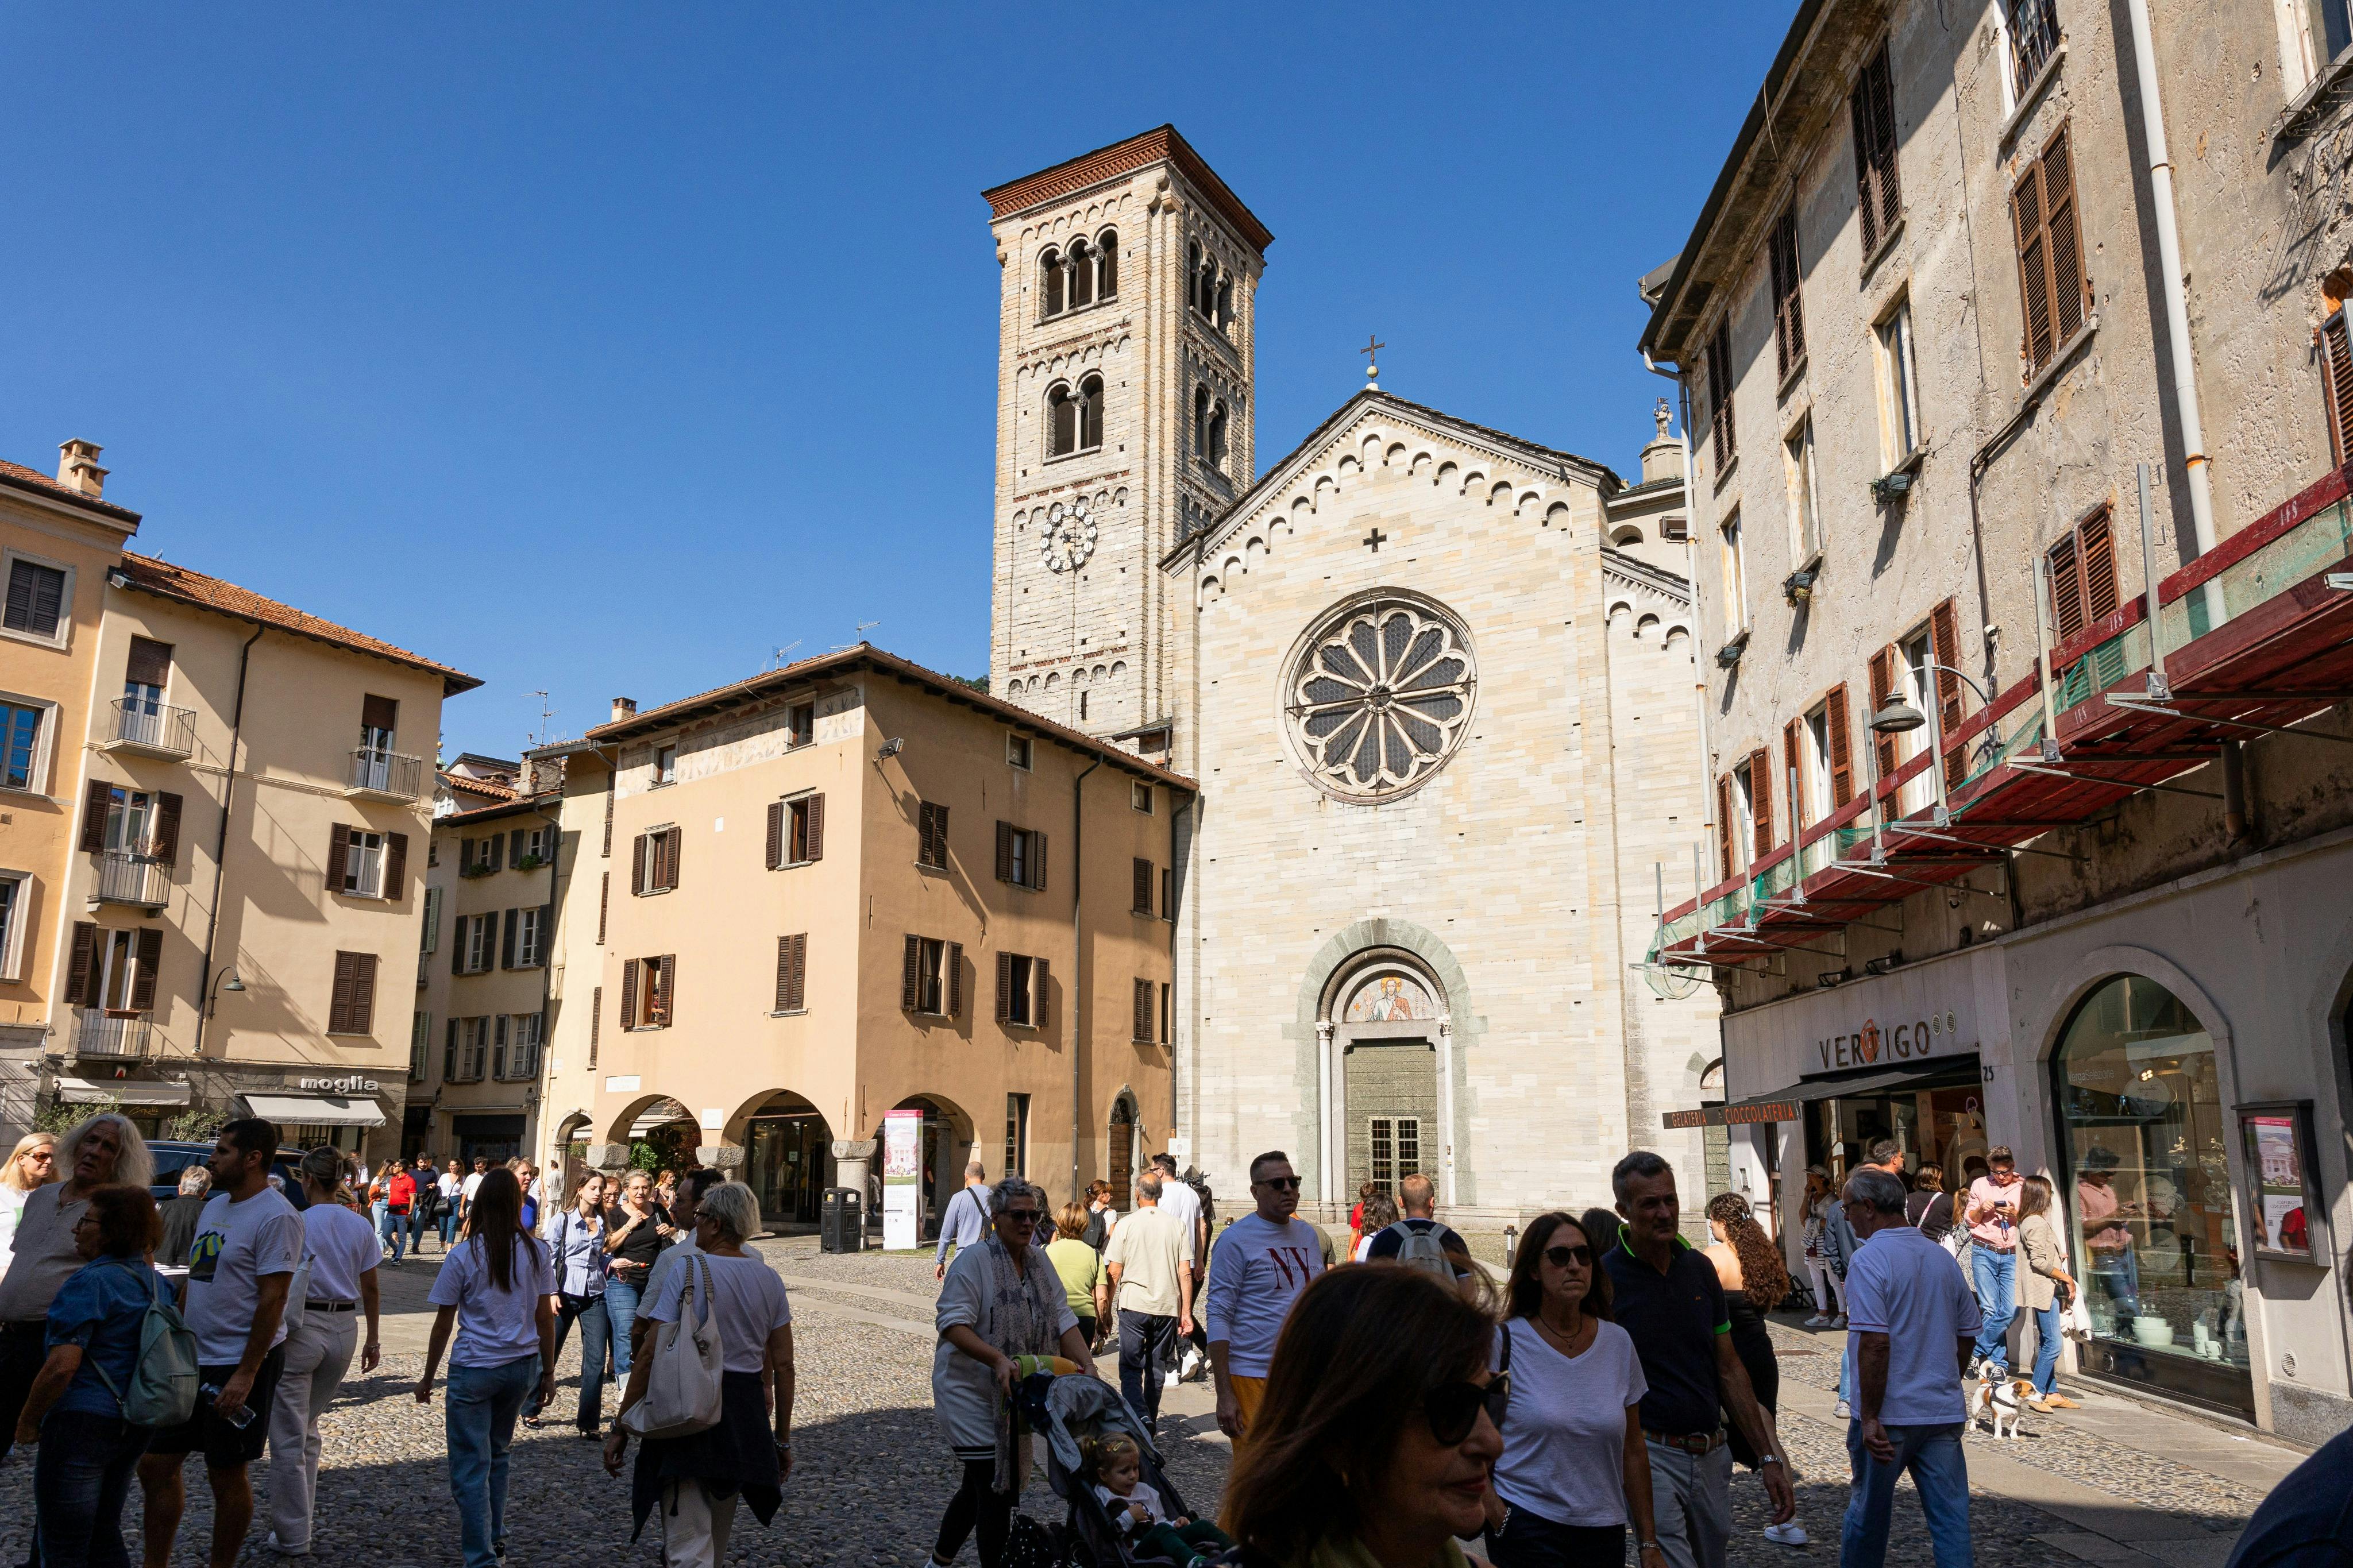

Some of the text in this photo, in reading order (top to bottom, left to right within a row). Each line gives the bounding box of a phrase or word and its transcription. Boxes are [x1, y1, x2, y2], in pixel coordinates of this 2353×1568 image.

[1819, 1021, 1931, 1069] VERTIGO
[1982, 1065, 1995, 1082] 25
[300, 1075, 379, 1094] moglia
[1671, 1111, 1707, 1127] GELATERIA
[1725, 1103, 1796, 1125] CIOCCOLATERIA
[1266, 1247, 1310, 1291] NY
